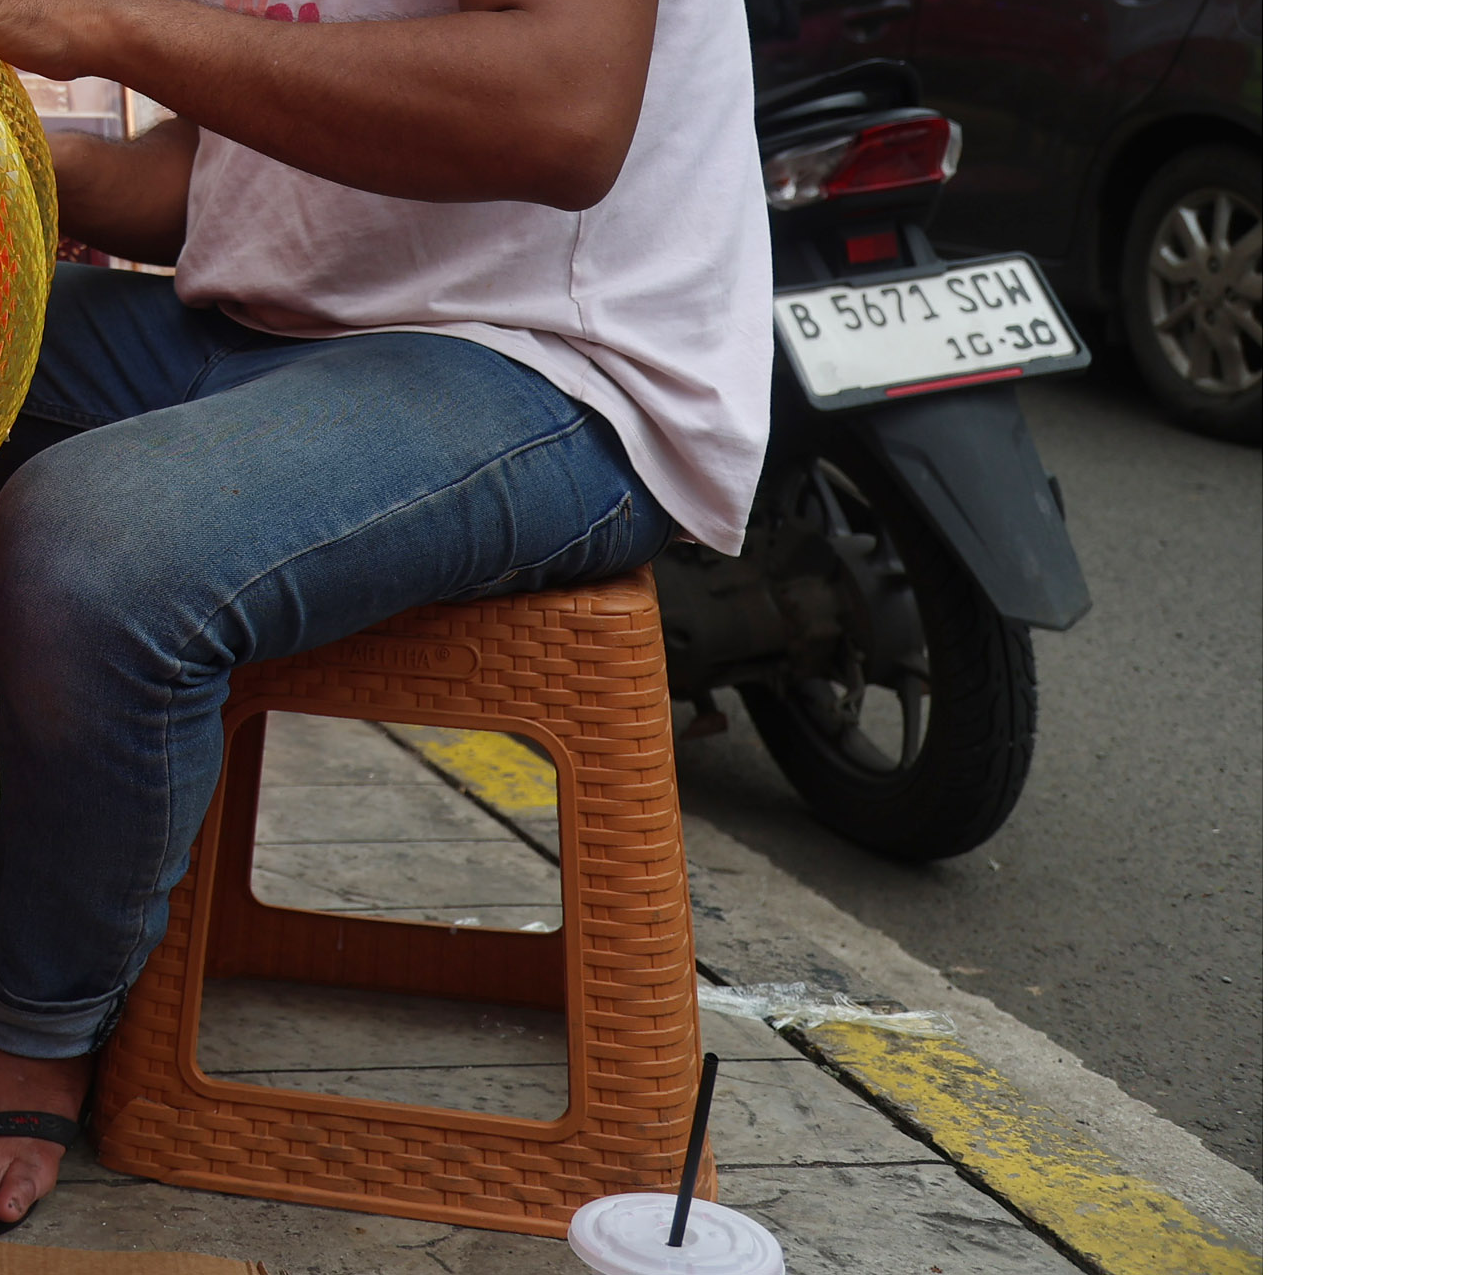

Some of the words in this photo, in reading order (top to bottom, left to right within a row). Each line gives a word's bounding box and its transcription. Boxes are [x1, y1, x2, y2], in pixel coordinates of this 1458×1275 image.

[790, 303, 820, 340] B
[831, 284, 939, 330] 5671
[947, 269, 1032, 313] SCW
